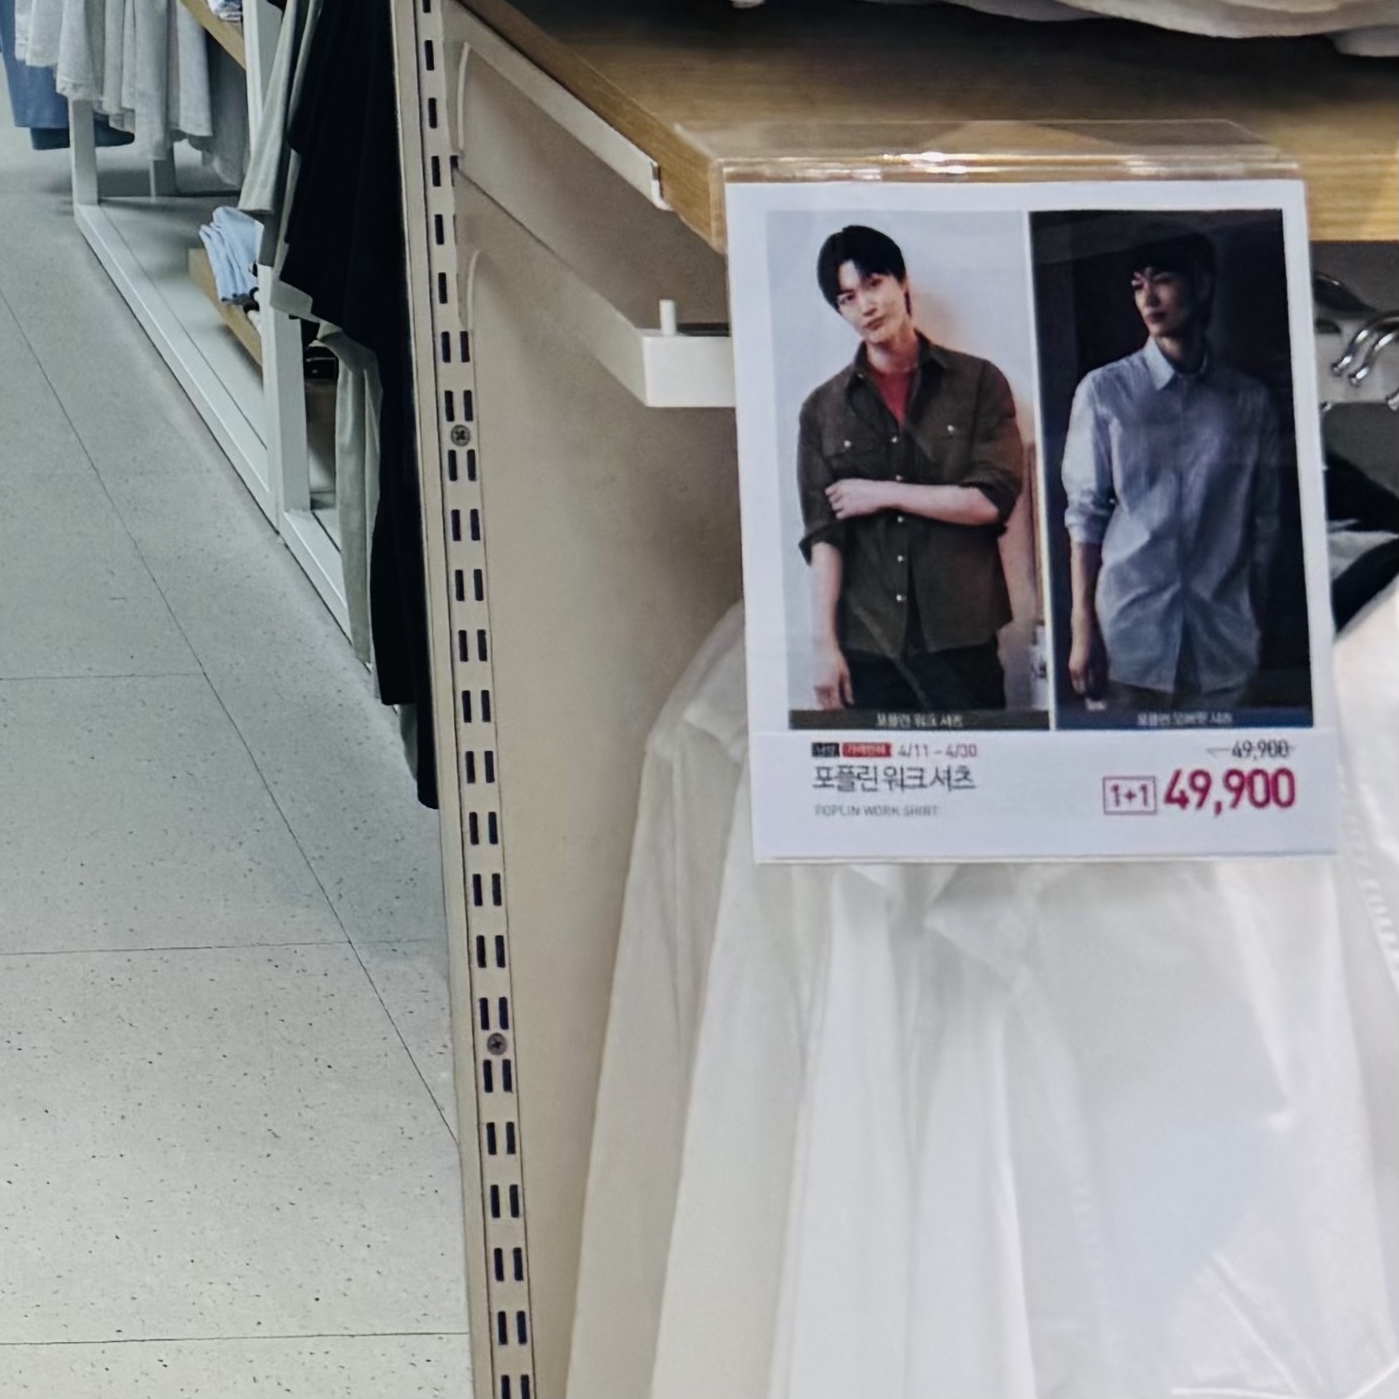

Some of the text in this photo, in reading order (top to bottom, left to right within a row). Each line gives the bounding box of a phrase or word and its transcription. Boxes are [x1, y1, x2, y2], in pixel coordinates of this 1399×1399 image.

[1231, 739, 1290, 760] 49,900
[812, 764, 879, 793] 포플린
[1110, 767, 1296, 817] 1+1 49,900
